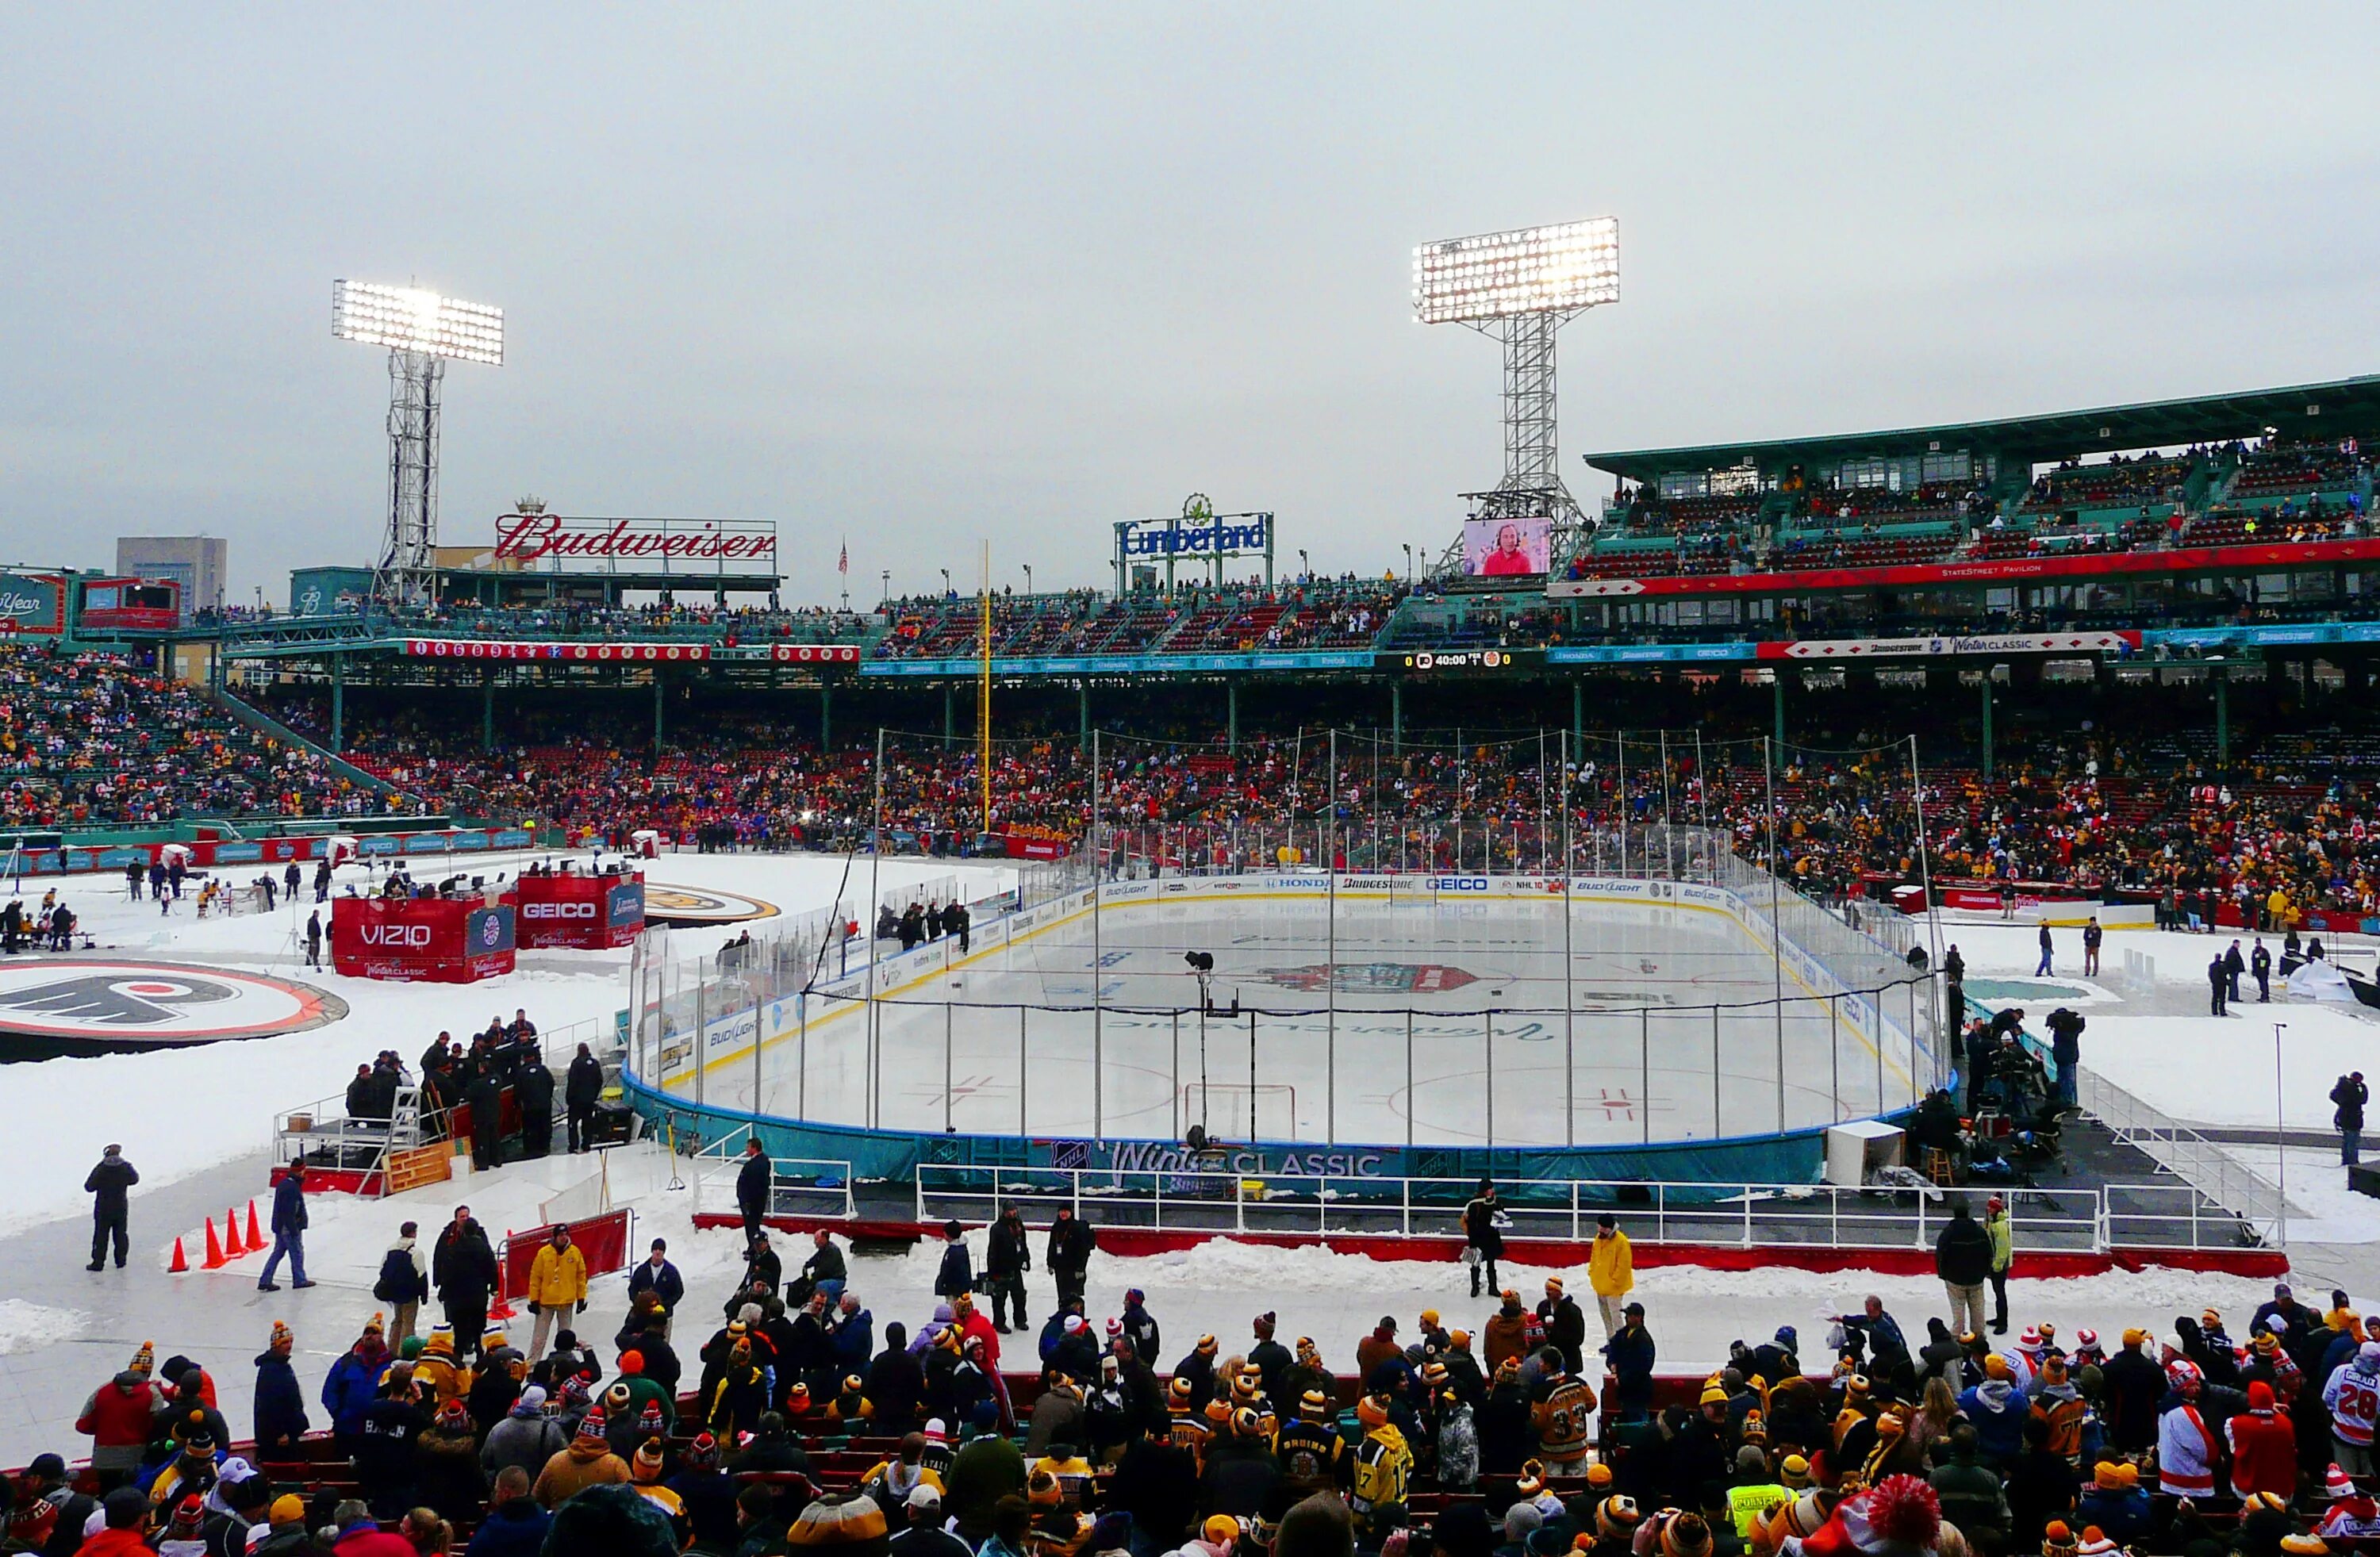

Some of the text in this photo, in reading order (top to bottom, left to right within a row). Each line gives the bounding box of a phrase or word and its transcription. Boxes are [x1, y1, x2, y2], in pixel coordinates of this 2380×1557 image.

[495, 514, 776, 560] Budweiser
[1121, 515, 1265, 554] Cumberland
[6, 593, 40, 613] Year
[1871, 643, 1923, 654] BRIDGESTONE
[1950, 635, 2032, 653] Winter CLASSIC
[1405, 656, 1412, 667] 0
[1435, 654, 1466, 665] 40:00
[1503, 654, 1511, 665] 0
[1697, 649, 1729, 658] GEICO
[1105, 884, 1149, 896] BUD LIGHT
[1342, 878, 1414, 889] BRIDGESTONE
[1426, 878, 1488, 891] GEICO
[1606, 882, 1642, 892] LIGHT
[1683, 888, 1721, 901] BUD LIGHT
[523, 903, 596, 918] GEICO
[360, 925, 431, 945] VIZIO
[364, 962, 428, 977] Winter CLASSIC
[710, 1018, 763, 1047] BUD LIGH
[1060, 1149, 1083, 1169] NHL
[1098, 1141, 1200, 1188] Wint
[1233, 1152, 1381, 1176] CLASSIC
[2339, 1384, 2378, 1421] 28
[1284, 1439, 1326, 1453] BRUINS
